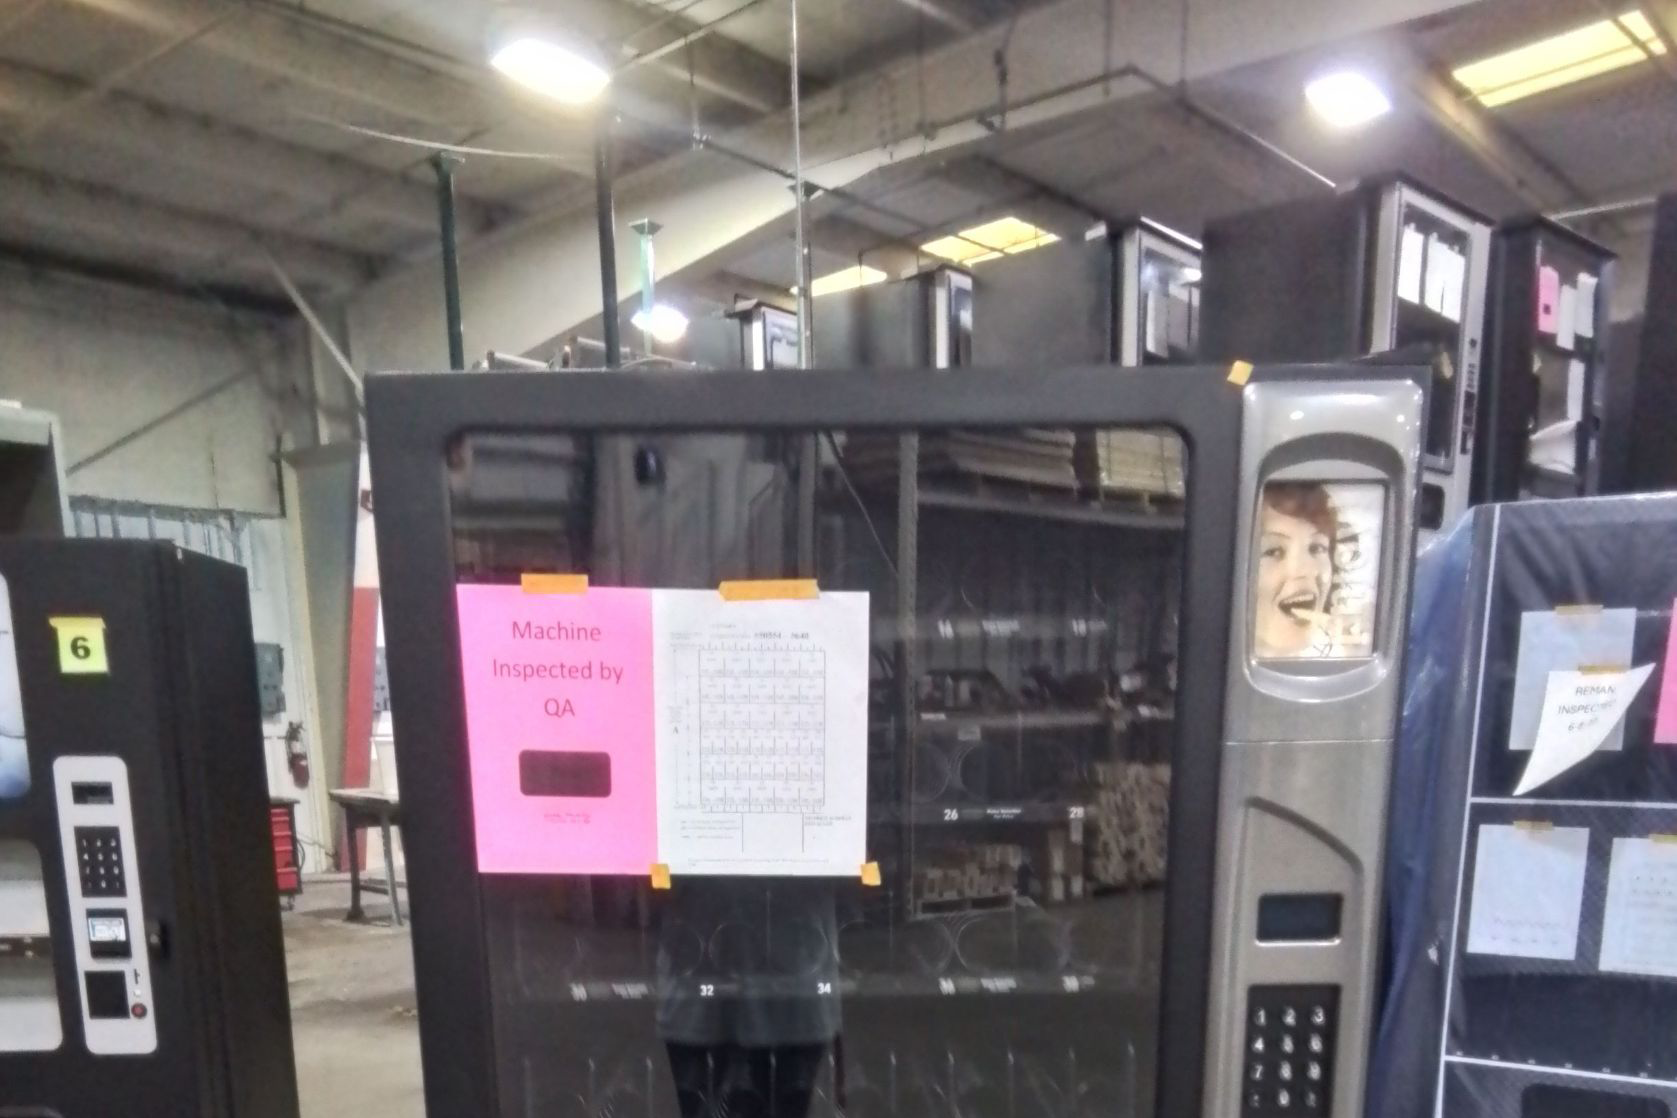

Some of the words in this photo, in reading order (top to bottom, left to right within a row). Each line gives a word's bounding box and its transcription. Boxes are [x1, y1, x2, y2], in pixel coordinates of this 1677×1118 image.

[512, 621, 602, 641] Machine
[70, 636, 91, 660] 6
[493, 658, 593, 682] Inspected
[600, 660, 623, 685] by
[1575, 686, 1617, 696] REMAN
[543, 698, 576, 719] QA
[943, 807, 959, 821] 26
[700, 984, 714, 997] 32
[817, 982, 832, 995] 34
[1284, 1007, 1296, 1026] 2
[1313, 1006, 1325, 1025] 3
